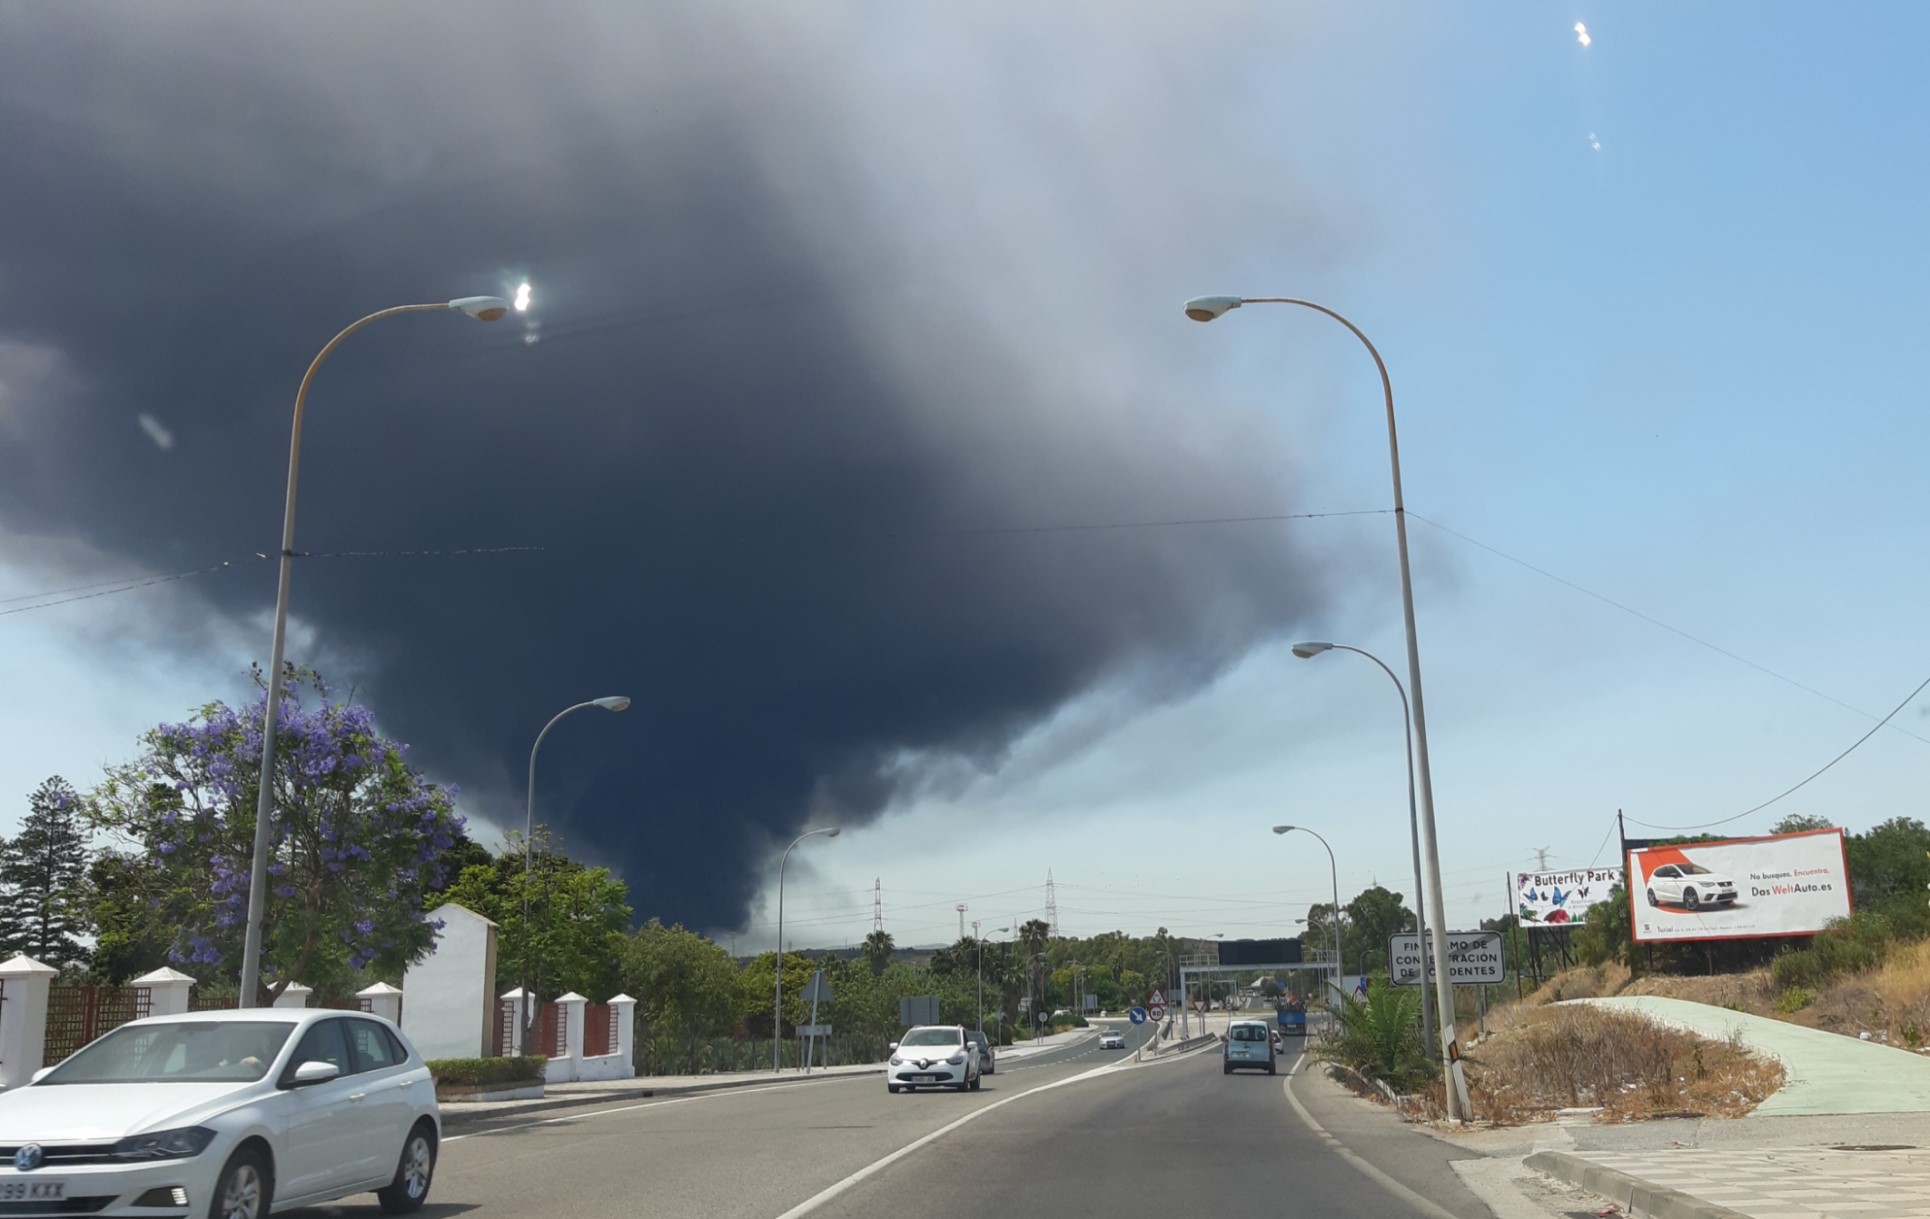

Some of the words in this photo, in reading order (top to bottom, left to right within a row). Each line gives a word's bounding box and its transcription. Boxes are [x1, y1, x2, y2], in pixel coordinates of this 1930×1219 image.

[1534, 871, 1584, 887] Butterfly
[1587, 869, 1615, 882] Park
[1794, 867, 1830, 877] Encuentra.
[1751, 886, 1771, 897] Das
[1772, 883, 1832, 895] WeltAuto.es
[1404, 942, 1420, 951] FIN
[1427, 940, 1468, 951] TMO
[1473, 940, 1488, 949] DE
[1396, 951, 1497, 965] CONERACIÓN
[1400, 968, 1416, 978] DE
[1423, 966, 1496, 977] CDENTES
